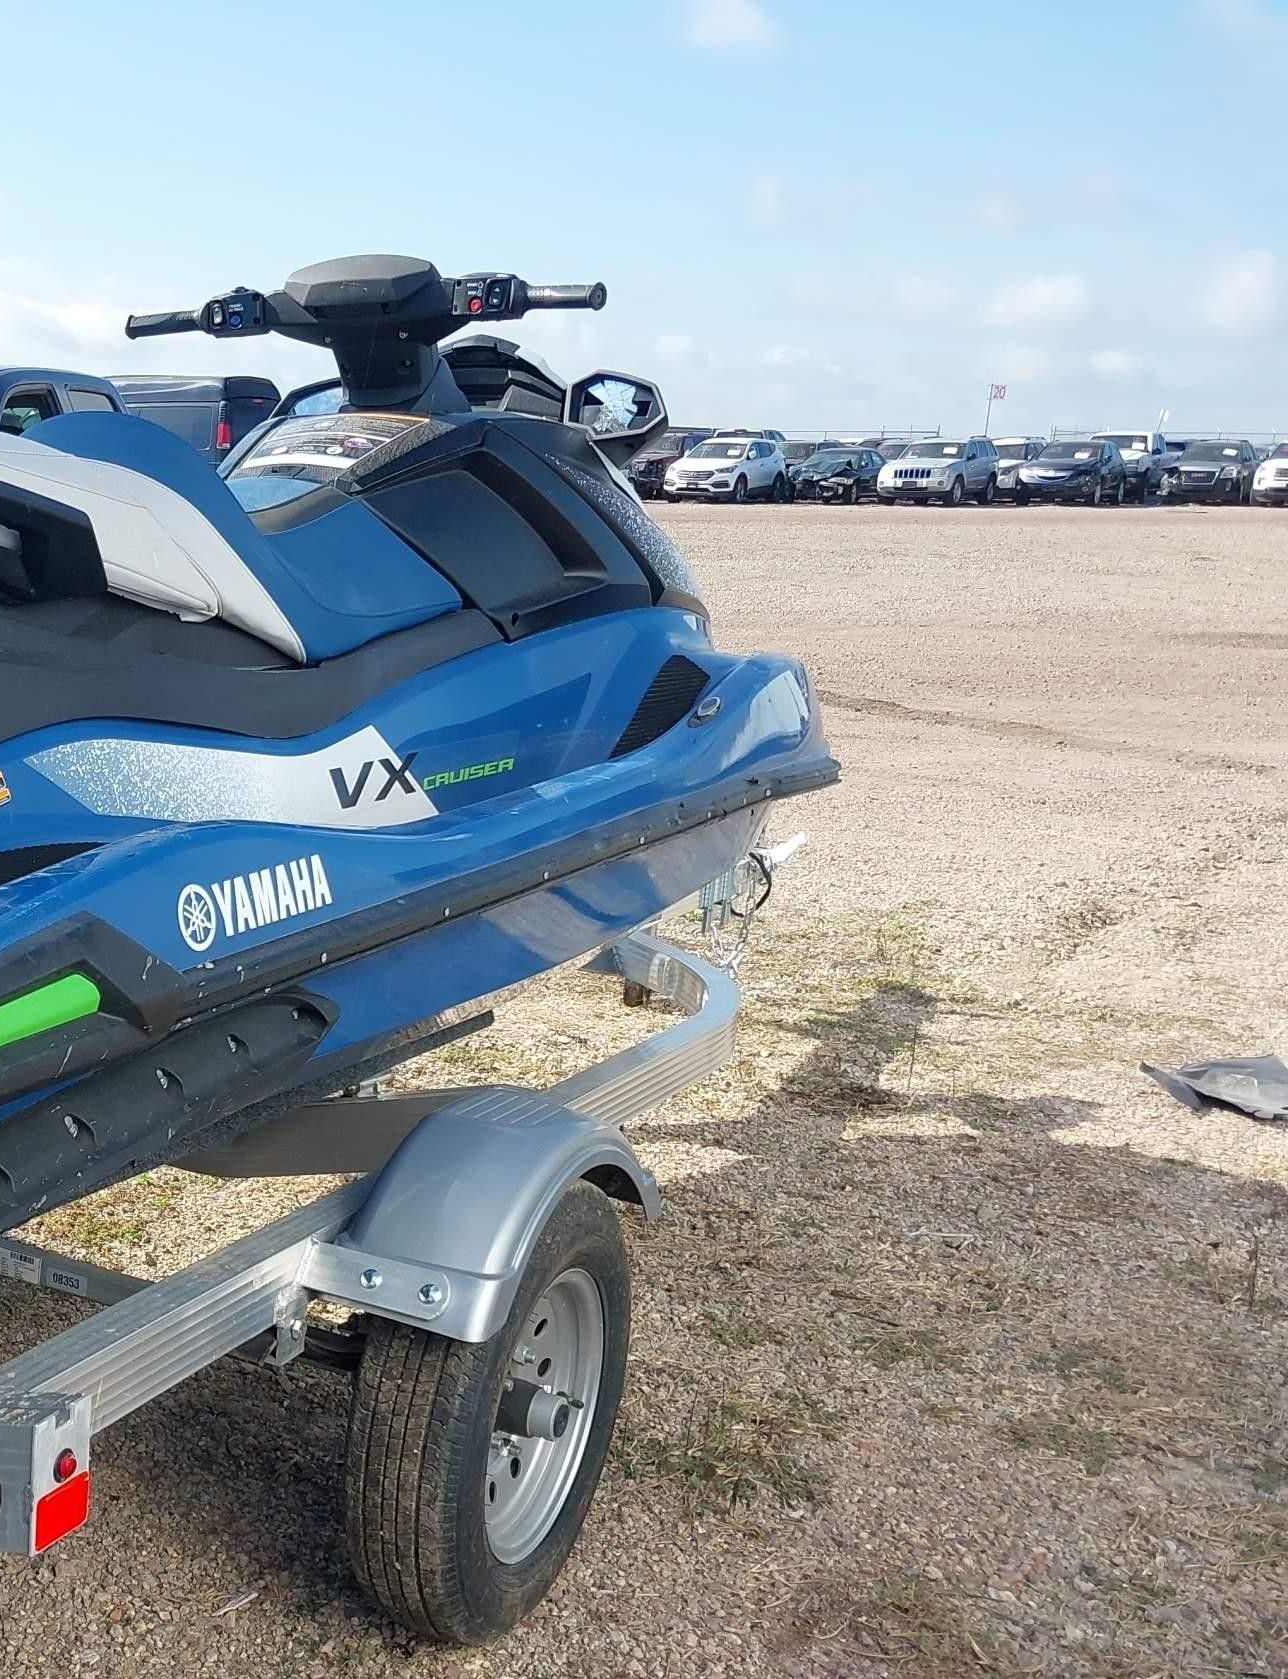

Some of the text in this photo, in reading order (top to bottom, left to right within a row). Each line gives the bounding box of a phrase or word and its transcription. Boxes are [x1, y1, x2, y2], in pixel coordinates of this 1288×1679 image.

[993, 386, 1006, 399] 20
[329, 752, 514, 809] VX CRUISER
[211, 854, 332, 937] YAMAHA
[52, 1272, 80, 1289] 08353
